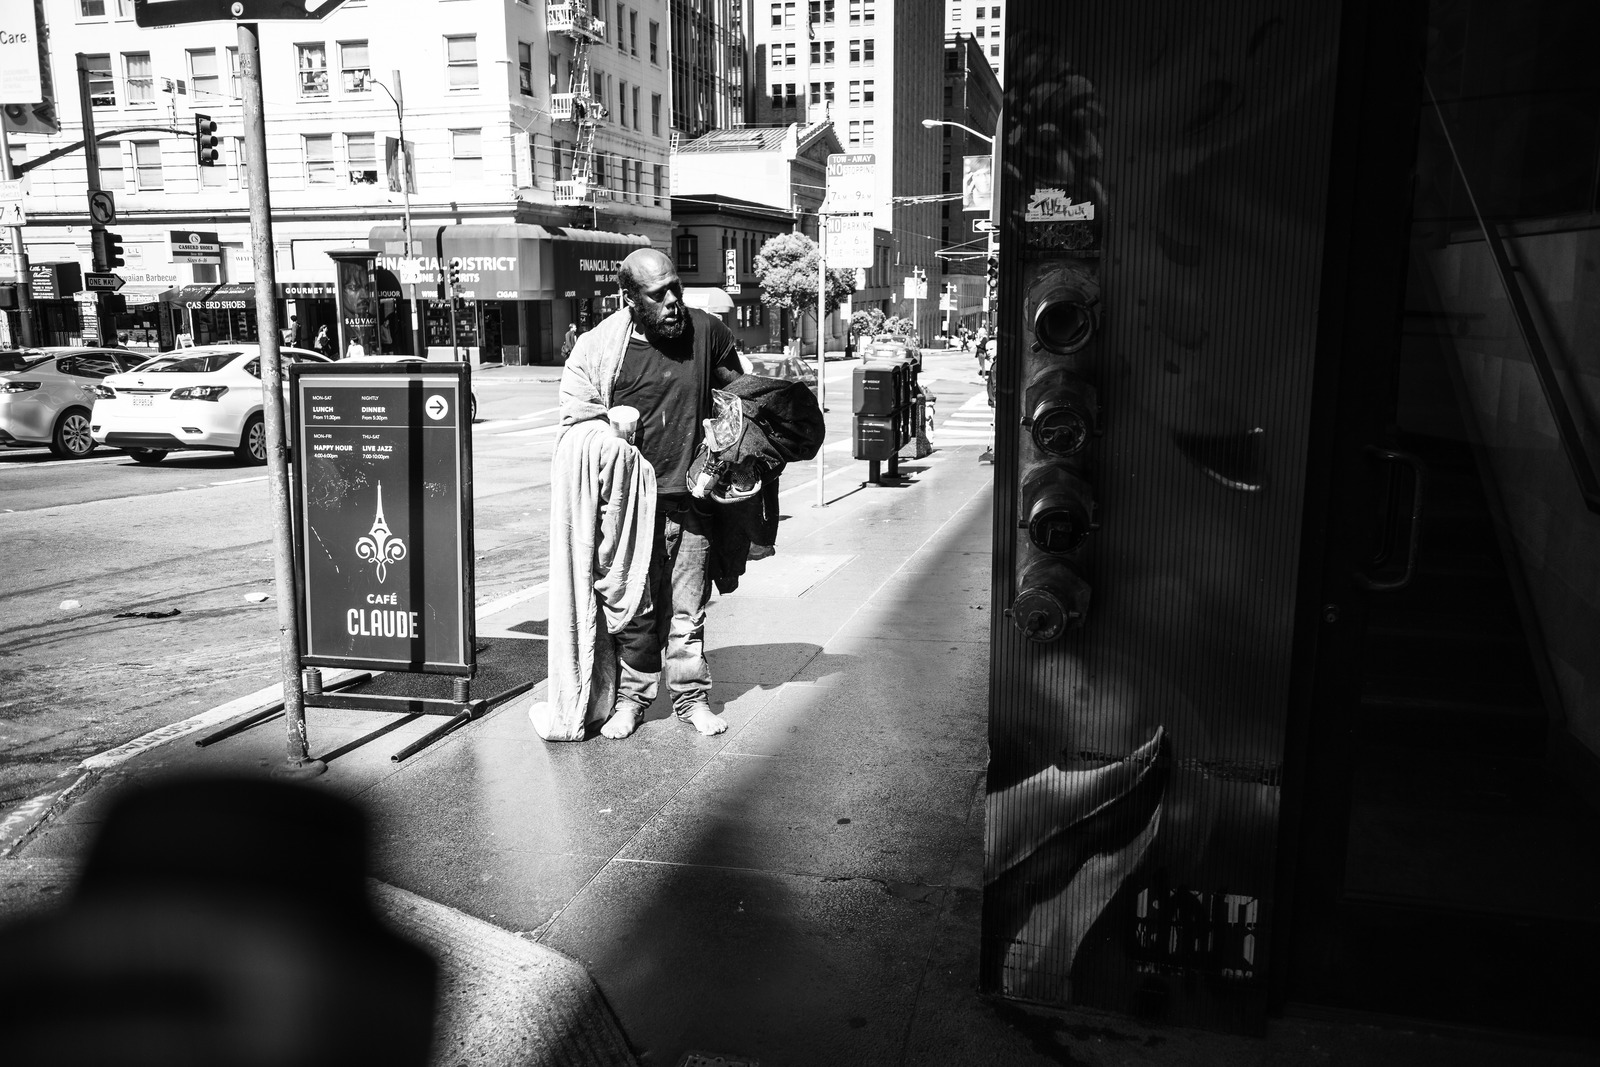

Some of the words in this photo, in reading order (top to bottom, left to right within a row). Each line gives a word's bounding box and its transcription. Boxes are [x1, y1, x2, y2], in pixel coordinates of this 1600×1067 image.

[0, 30, 31, 45] Care.
[829, 164, 843, 175] NO
[844, 166, 875, 175] STOPPING
[828, 219, 841, 232] NO
[843, 221, 871, 230] PARKING
[579, 259, 610, 272] FINANCIAL
[89, 278, 102, 286] ONE
[102, 278, 114, 286] WAY
[146, 273, 178, 282] Barbecue
[284, 287, 324, 295] GOURMET
[378, 290, 400, 298] LIQUOR
[565, 290, 576, 298] LIQUOR
[186, 301, 220, 310] CASSERD
[221, 301, 247, 310] SHOES
[366, 592, 398, 605] CAFÉ
[347, 608, 419, 639] CLAUDE
